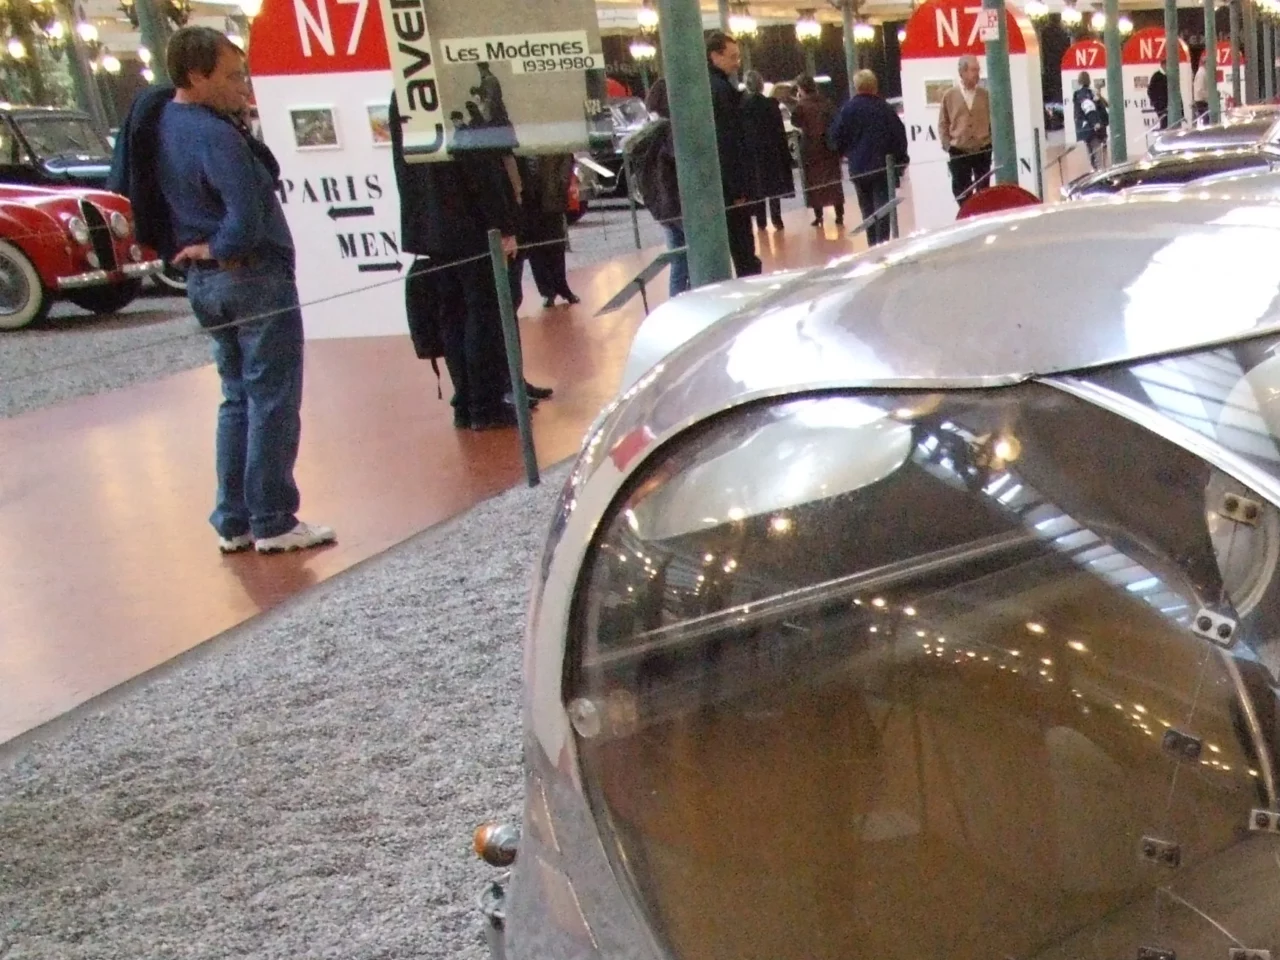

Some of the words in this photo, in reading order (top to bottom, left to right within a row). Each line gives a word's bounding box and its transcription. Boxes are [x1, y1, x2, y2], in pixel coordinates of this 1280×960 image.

[292, 0, 369, 57] N7
[935, 7, 983, 48] N7
[445, 44, 480, 63] Les
[485, 39, 584, 61] Modernes
[1075, 48, 1098, 66] N7
[1139, 38, 1166, 60] N7
[523, 55, 595, 73] 1939-1980
[278, 173, 383, 204] PARIS
[336, 231, 400, 259] MEN
